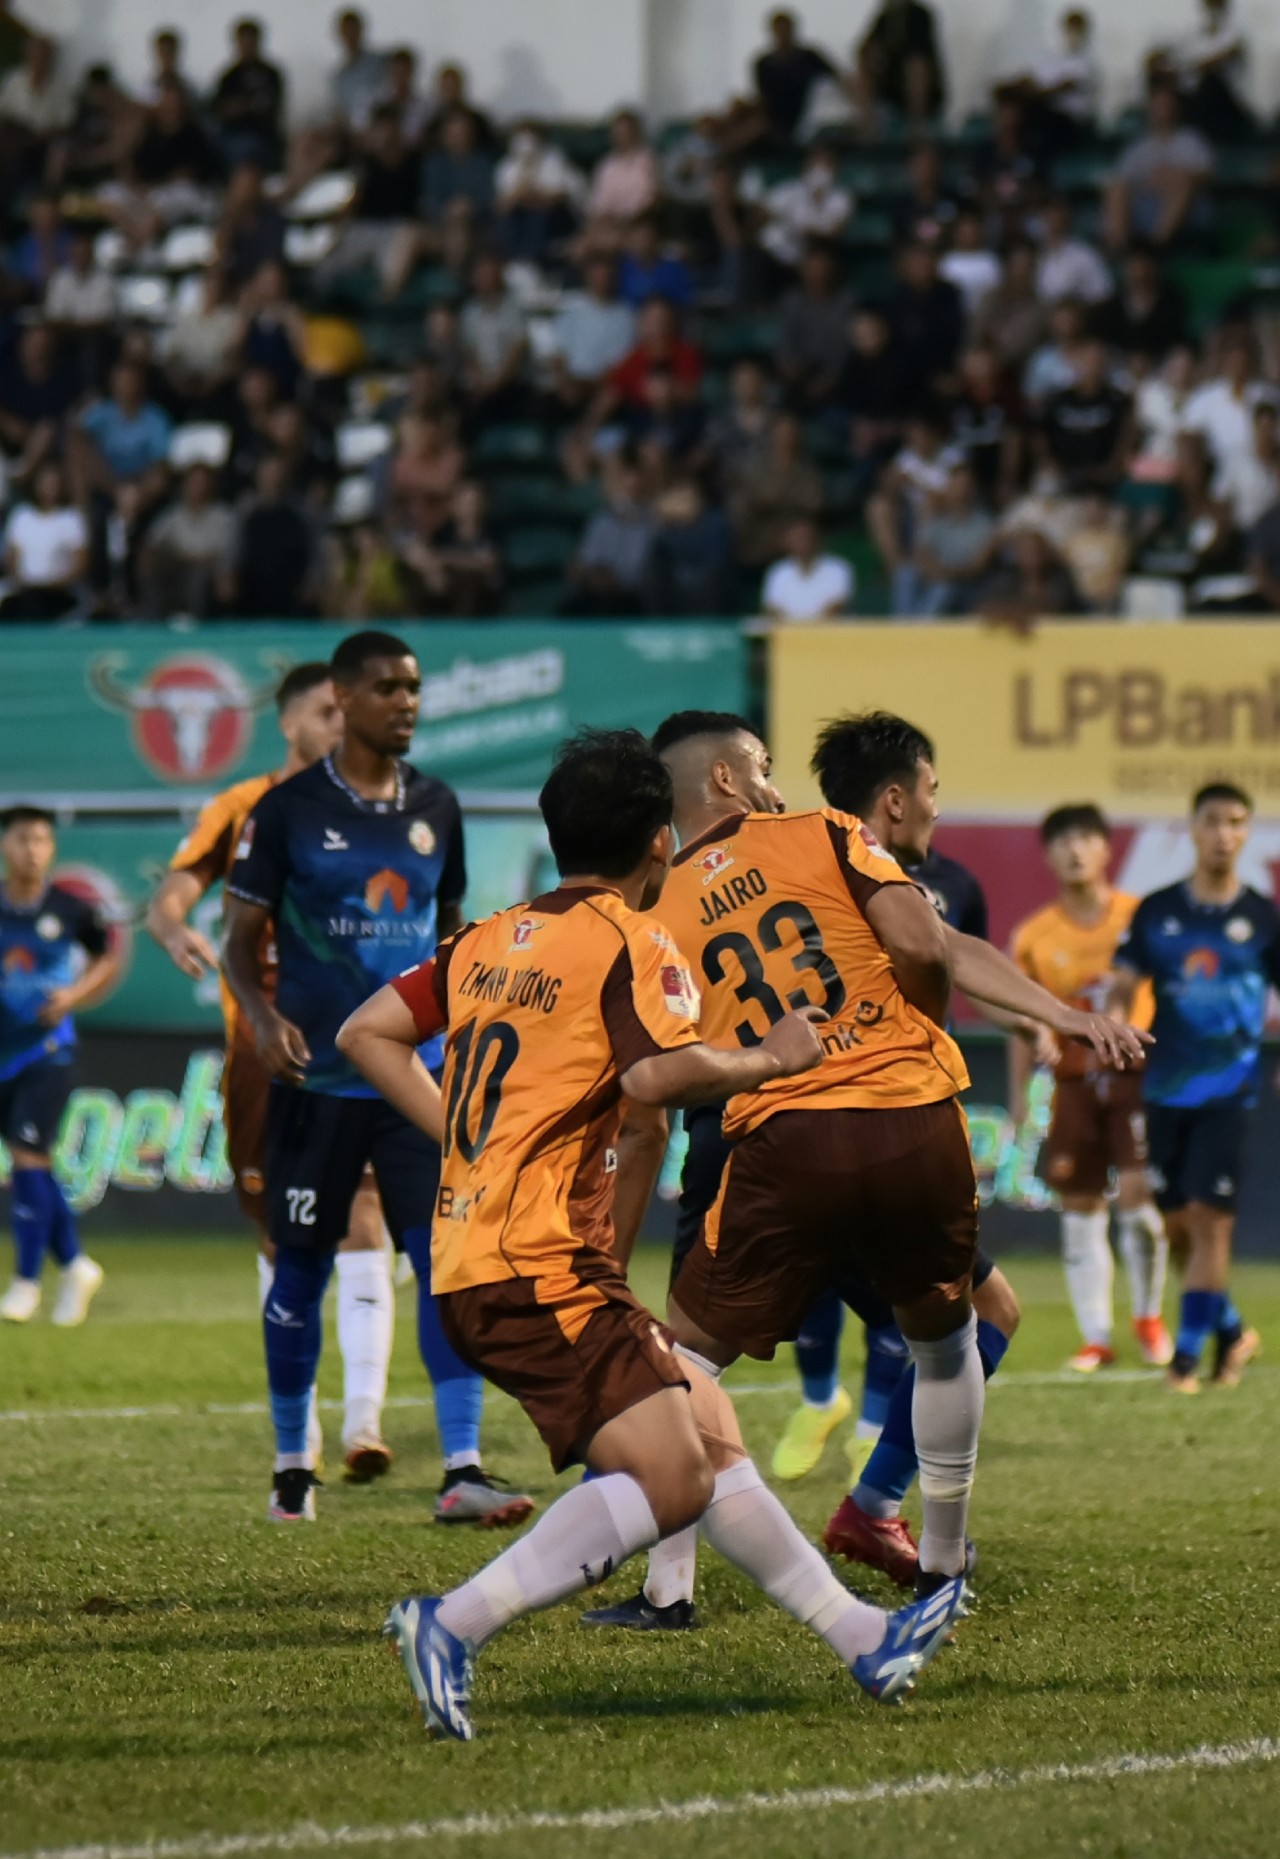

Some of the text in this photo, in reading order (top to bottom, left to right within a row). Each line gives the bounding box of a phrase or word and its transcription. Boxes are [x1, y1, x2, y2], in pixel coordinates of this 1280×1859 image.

[699, 868, 767, 926] JAIRO
[701, 900, 846, 1047] 33
[444, 1016, 520, 1166] 10
[286, 1189, 317, 1225] 72
